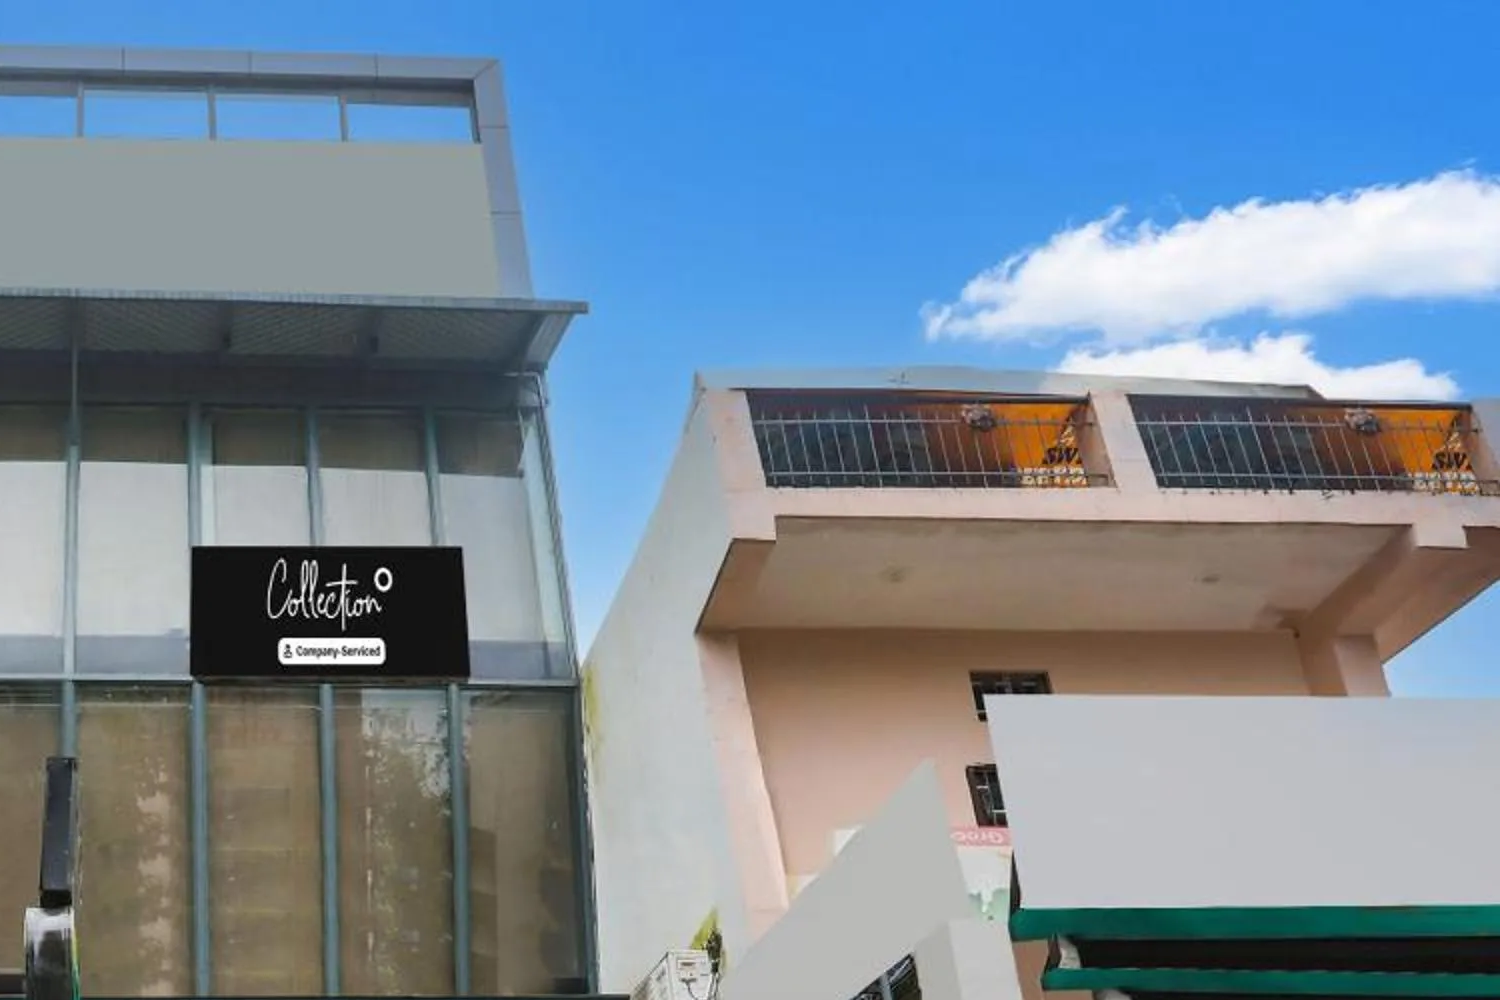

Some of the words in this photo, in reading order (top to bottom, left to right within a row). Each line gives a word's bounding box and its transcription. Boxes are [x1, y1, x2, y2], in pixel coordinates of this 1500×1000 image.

[1041, 447, 1082, 465] SW
[1431, 452, 1473, 470] SW
[266, 557, 382, 631] Collection
[295, 645, 381, 659] Company-Serviced
